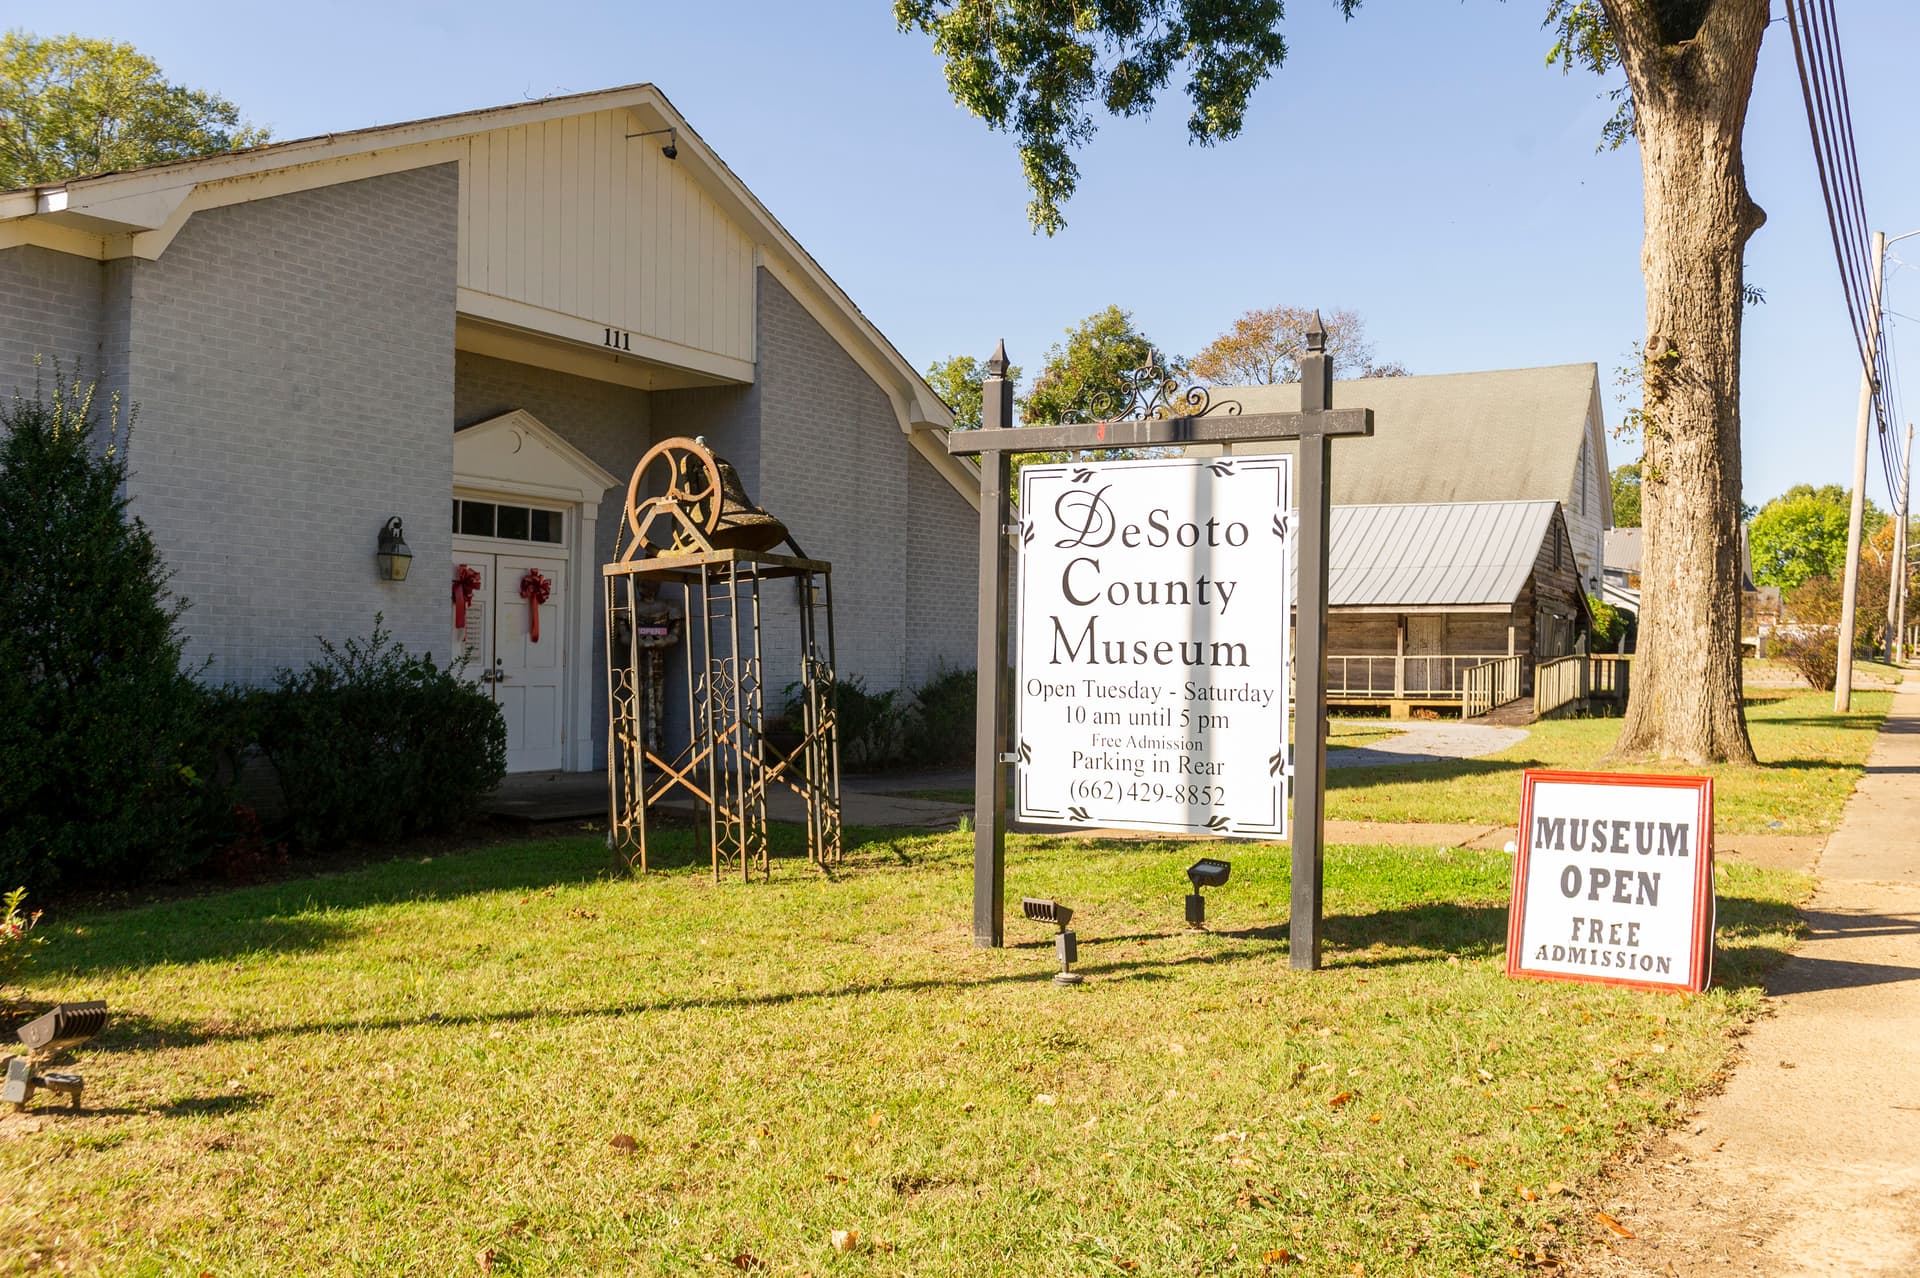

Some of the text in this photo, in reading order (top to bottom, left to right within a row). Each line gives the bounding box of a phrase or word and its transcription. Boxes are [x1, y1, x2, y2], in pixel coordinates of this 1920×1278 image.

[604, 328, 630, 351] 111
[1054, 484, 1249, 548] DeSoto
[1062, 557, 1238, 615] County
[1049, 615, 1250, 667] Museum
[1027, 678, 1076, 702] Open
[1083, 679, 1162, 704] Tuesday
[1184, 681, 1274, 708] Saturday
[1066, 705, 1229, 733] 10 am until 5 pm
[1092, 733, 1203, 751] Free Admission
[1072, 751, 1225, 777] Parking in Rear
[1535, 816, 1689, 857] MUSEUM
[1560, 864, 1661, 907] OPEN
[1571, 916, 1641, 947] FREE
[1535, 944, 1672, 974] ADMISSION
